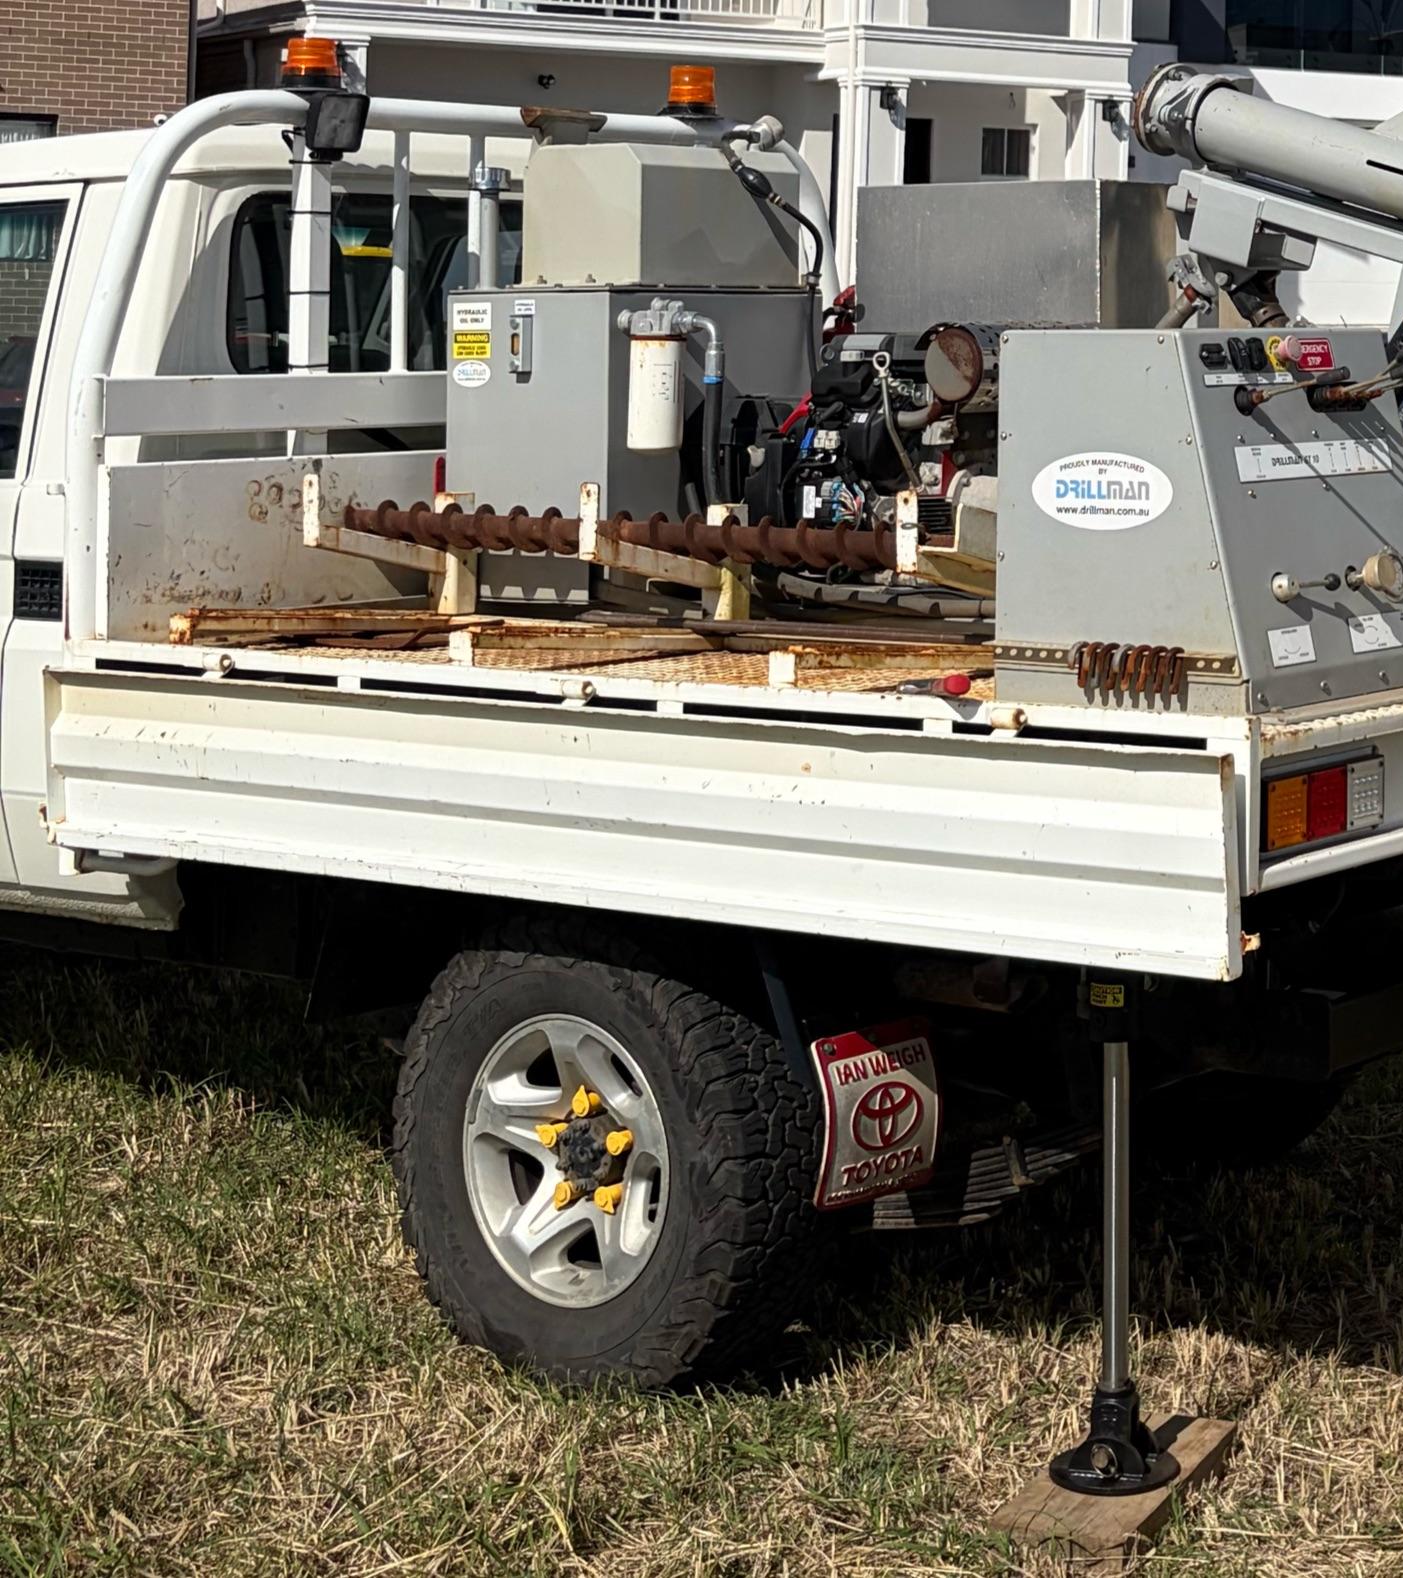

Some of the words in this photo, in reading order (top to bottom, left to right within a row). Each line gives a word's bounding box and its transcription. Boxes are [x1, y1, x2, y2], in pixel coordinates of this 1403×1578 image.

[456, 333, 488, 342] WARNING
[1301, 344, 1328, 353] ERGENCY
[1307, 356, 1322, 366] STOP
[1059, 459, 1090, 472] PROUDLY
[1091, 459, 1145, 474] MANUFACTURED
[1056, 505, 1150, 517] www.drillman.com.au
[835, 1059, 869, 1086] IAN
[869, 1043, 927, 1076] WEIGH
[840, 1144, 925, 1187] TOYOTA
